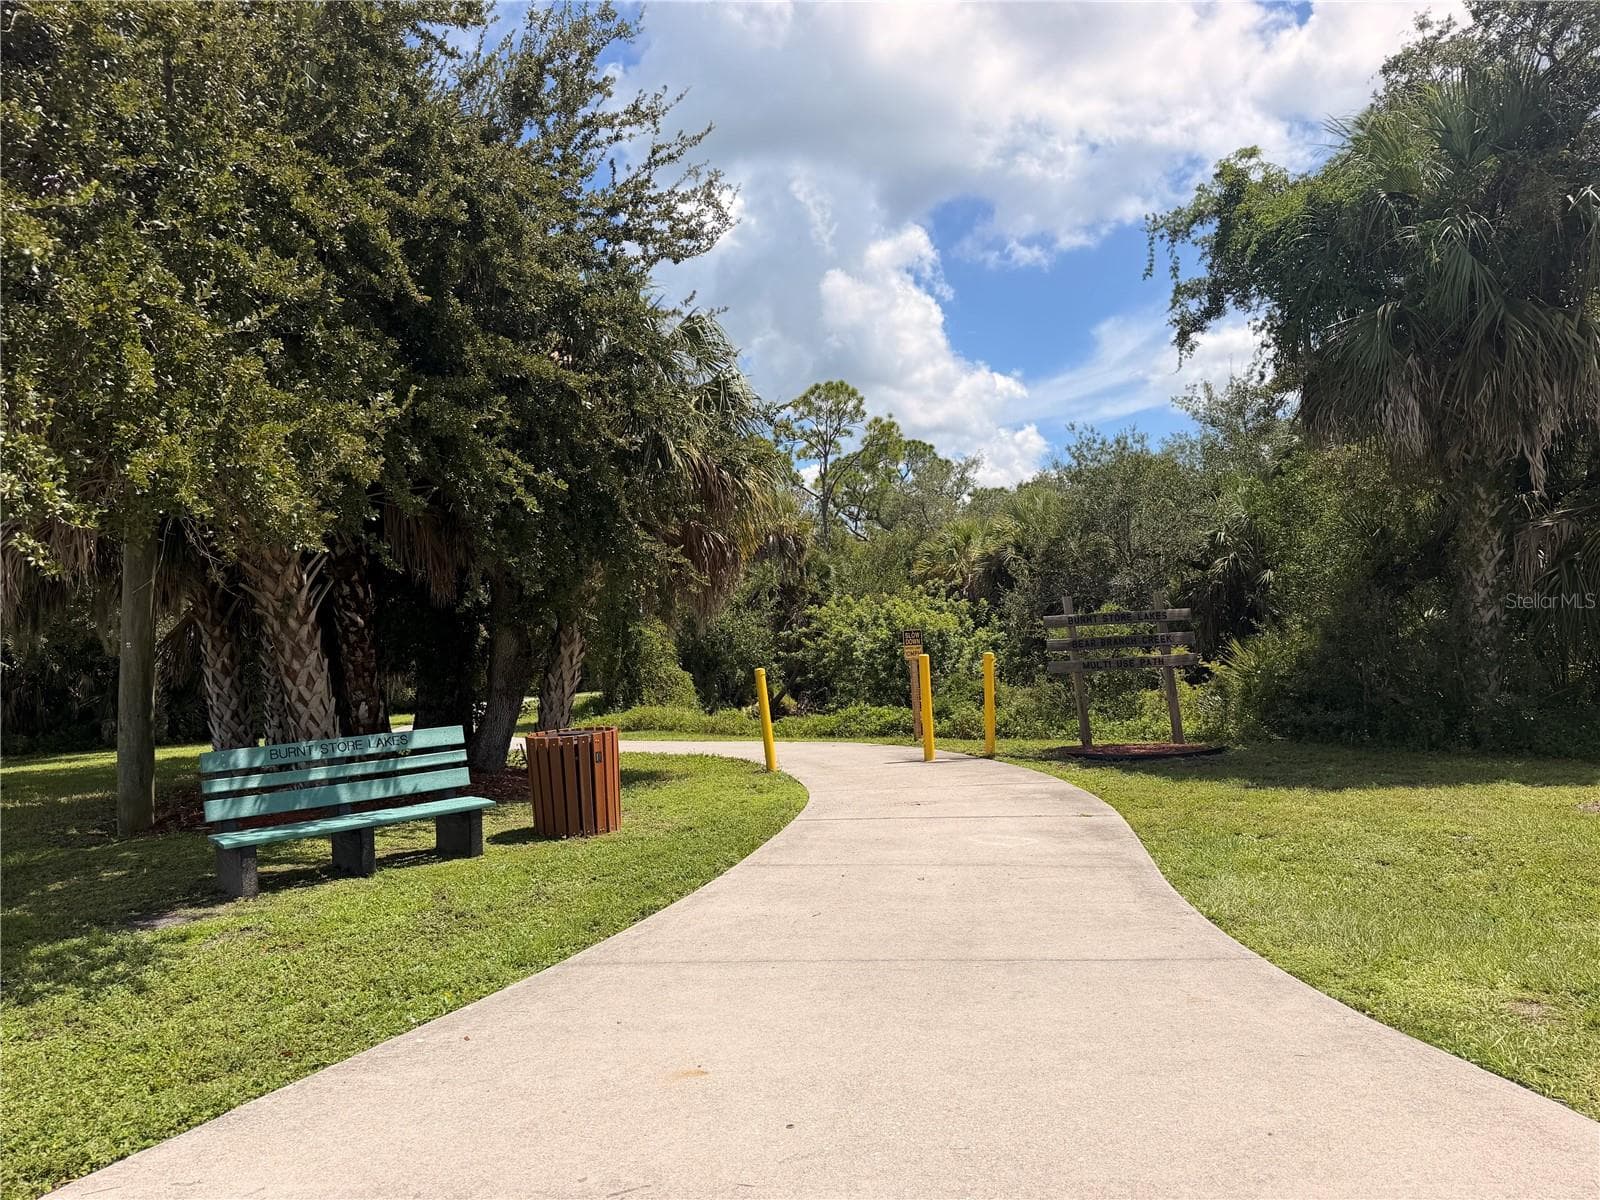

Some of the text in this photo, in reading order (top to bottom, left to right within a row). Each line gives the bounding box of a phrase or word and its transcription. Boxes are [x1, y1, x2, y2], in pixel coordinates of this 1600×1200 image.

[1067, 611, 1168, 625] BURNT STORE LAKES
[1072, 634, 1172, 649] BEAR BRANCH CREEK
[1082, 657, 1165, 669] MULTI USE PATH
[269, 734, 409, 760] BURNT STORE LAKES
